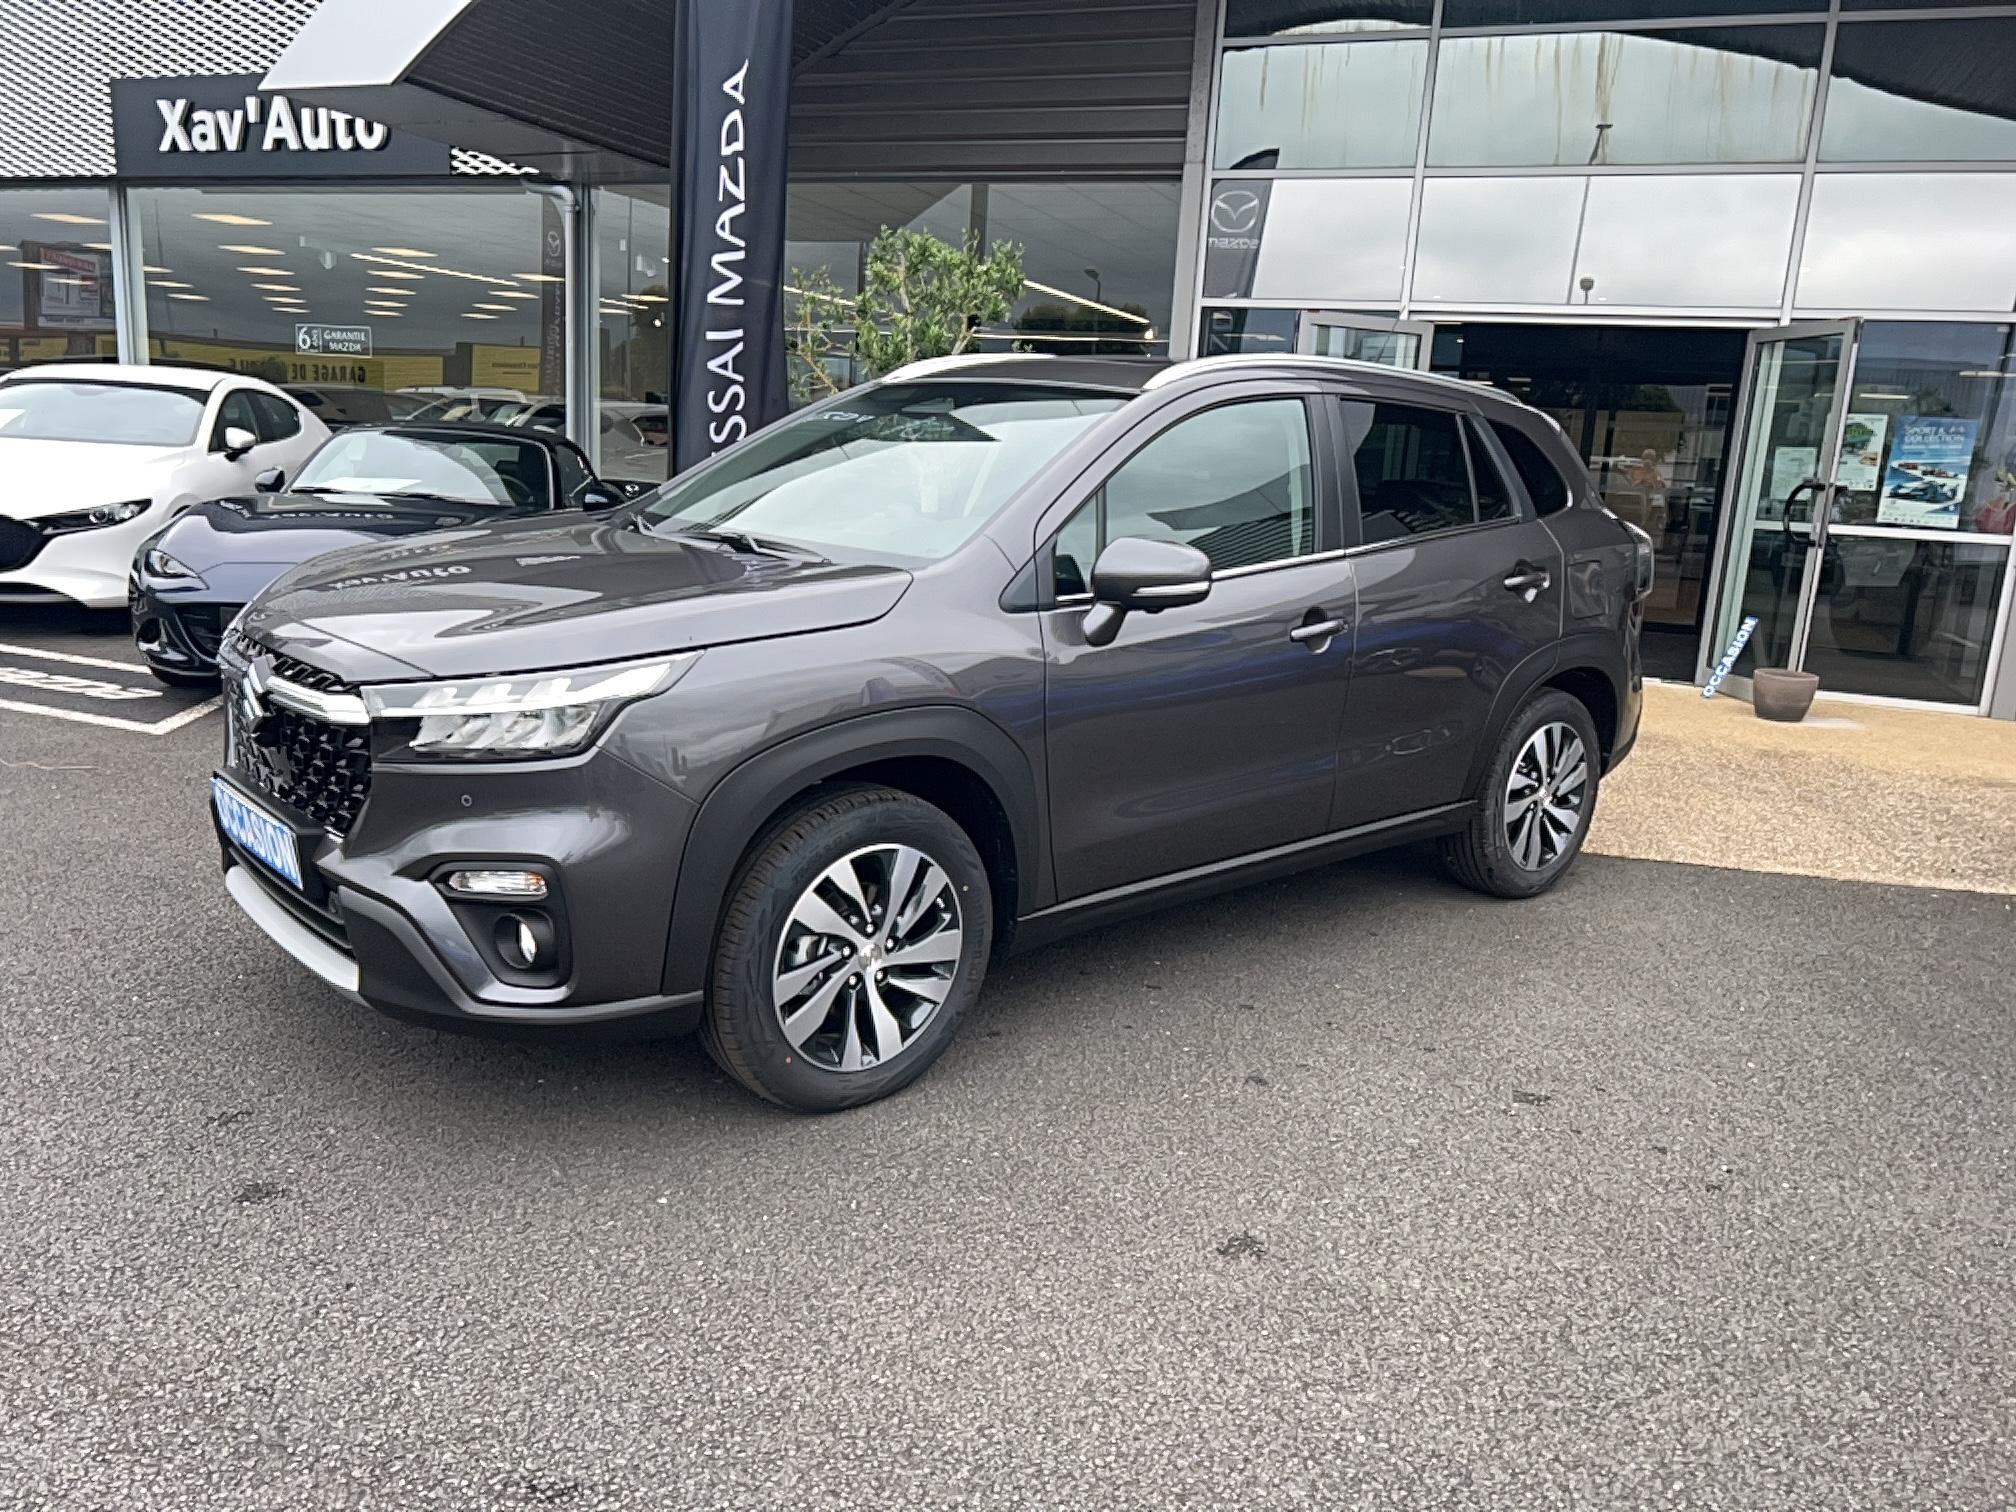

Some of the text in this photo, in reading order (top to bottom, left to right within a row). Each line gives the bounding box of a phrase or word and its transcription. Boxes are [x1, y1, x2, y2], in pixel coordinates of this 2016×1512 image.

[156, 95, 388, 151] Xav'Auto
[705, 58, 750, 458] SSAI MAZDA
[299, 326, 311, 350] 6
[323, 329, 366, 341] GARANTIE
[328, 341, 361, 352] MAZDA
[1703, 616, 1758, 698] OCCASION
